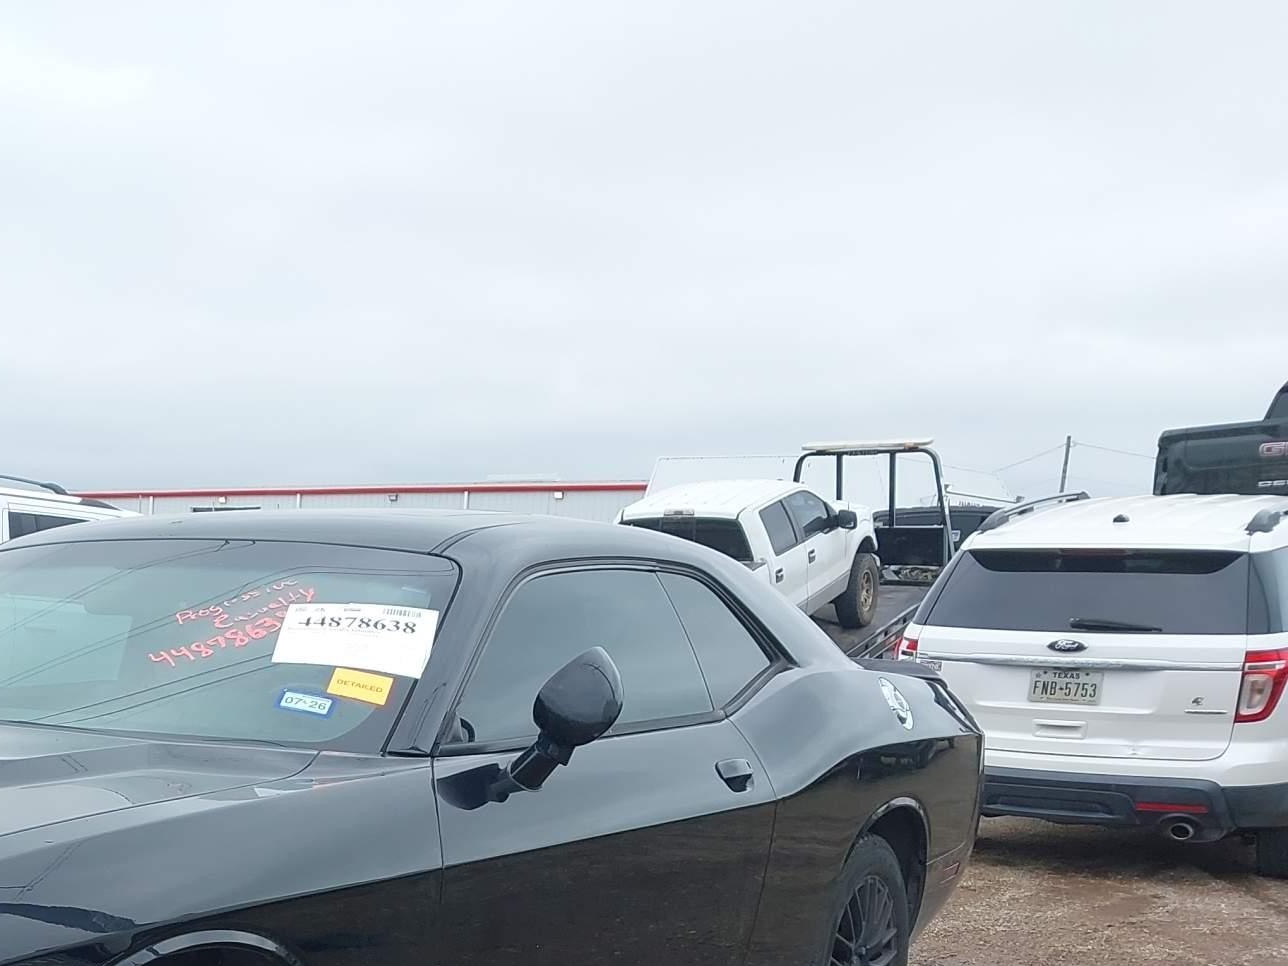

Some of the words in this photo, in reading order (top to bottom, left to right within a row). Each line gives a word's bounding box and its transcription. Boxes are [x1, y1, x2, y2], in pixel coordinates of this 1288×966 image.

[298, 615, 418, 635] 44878638
[1053, 671, 1081, 680] TEXAS
[336, 679, 384, 693] DETAILED
